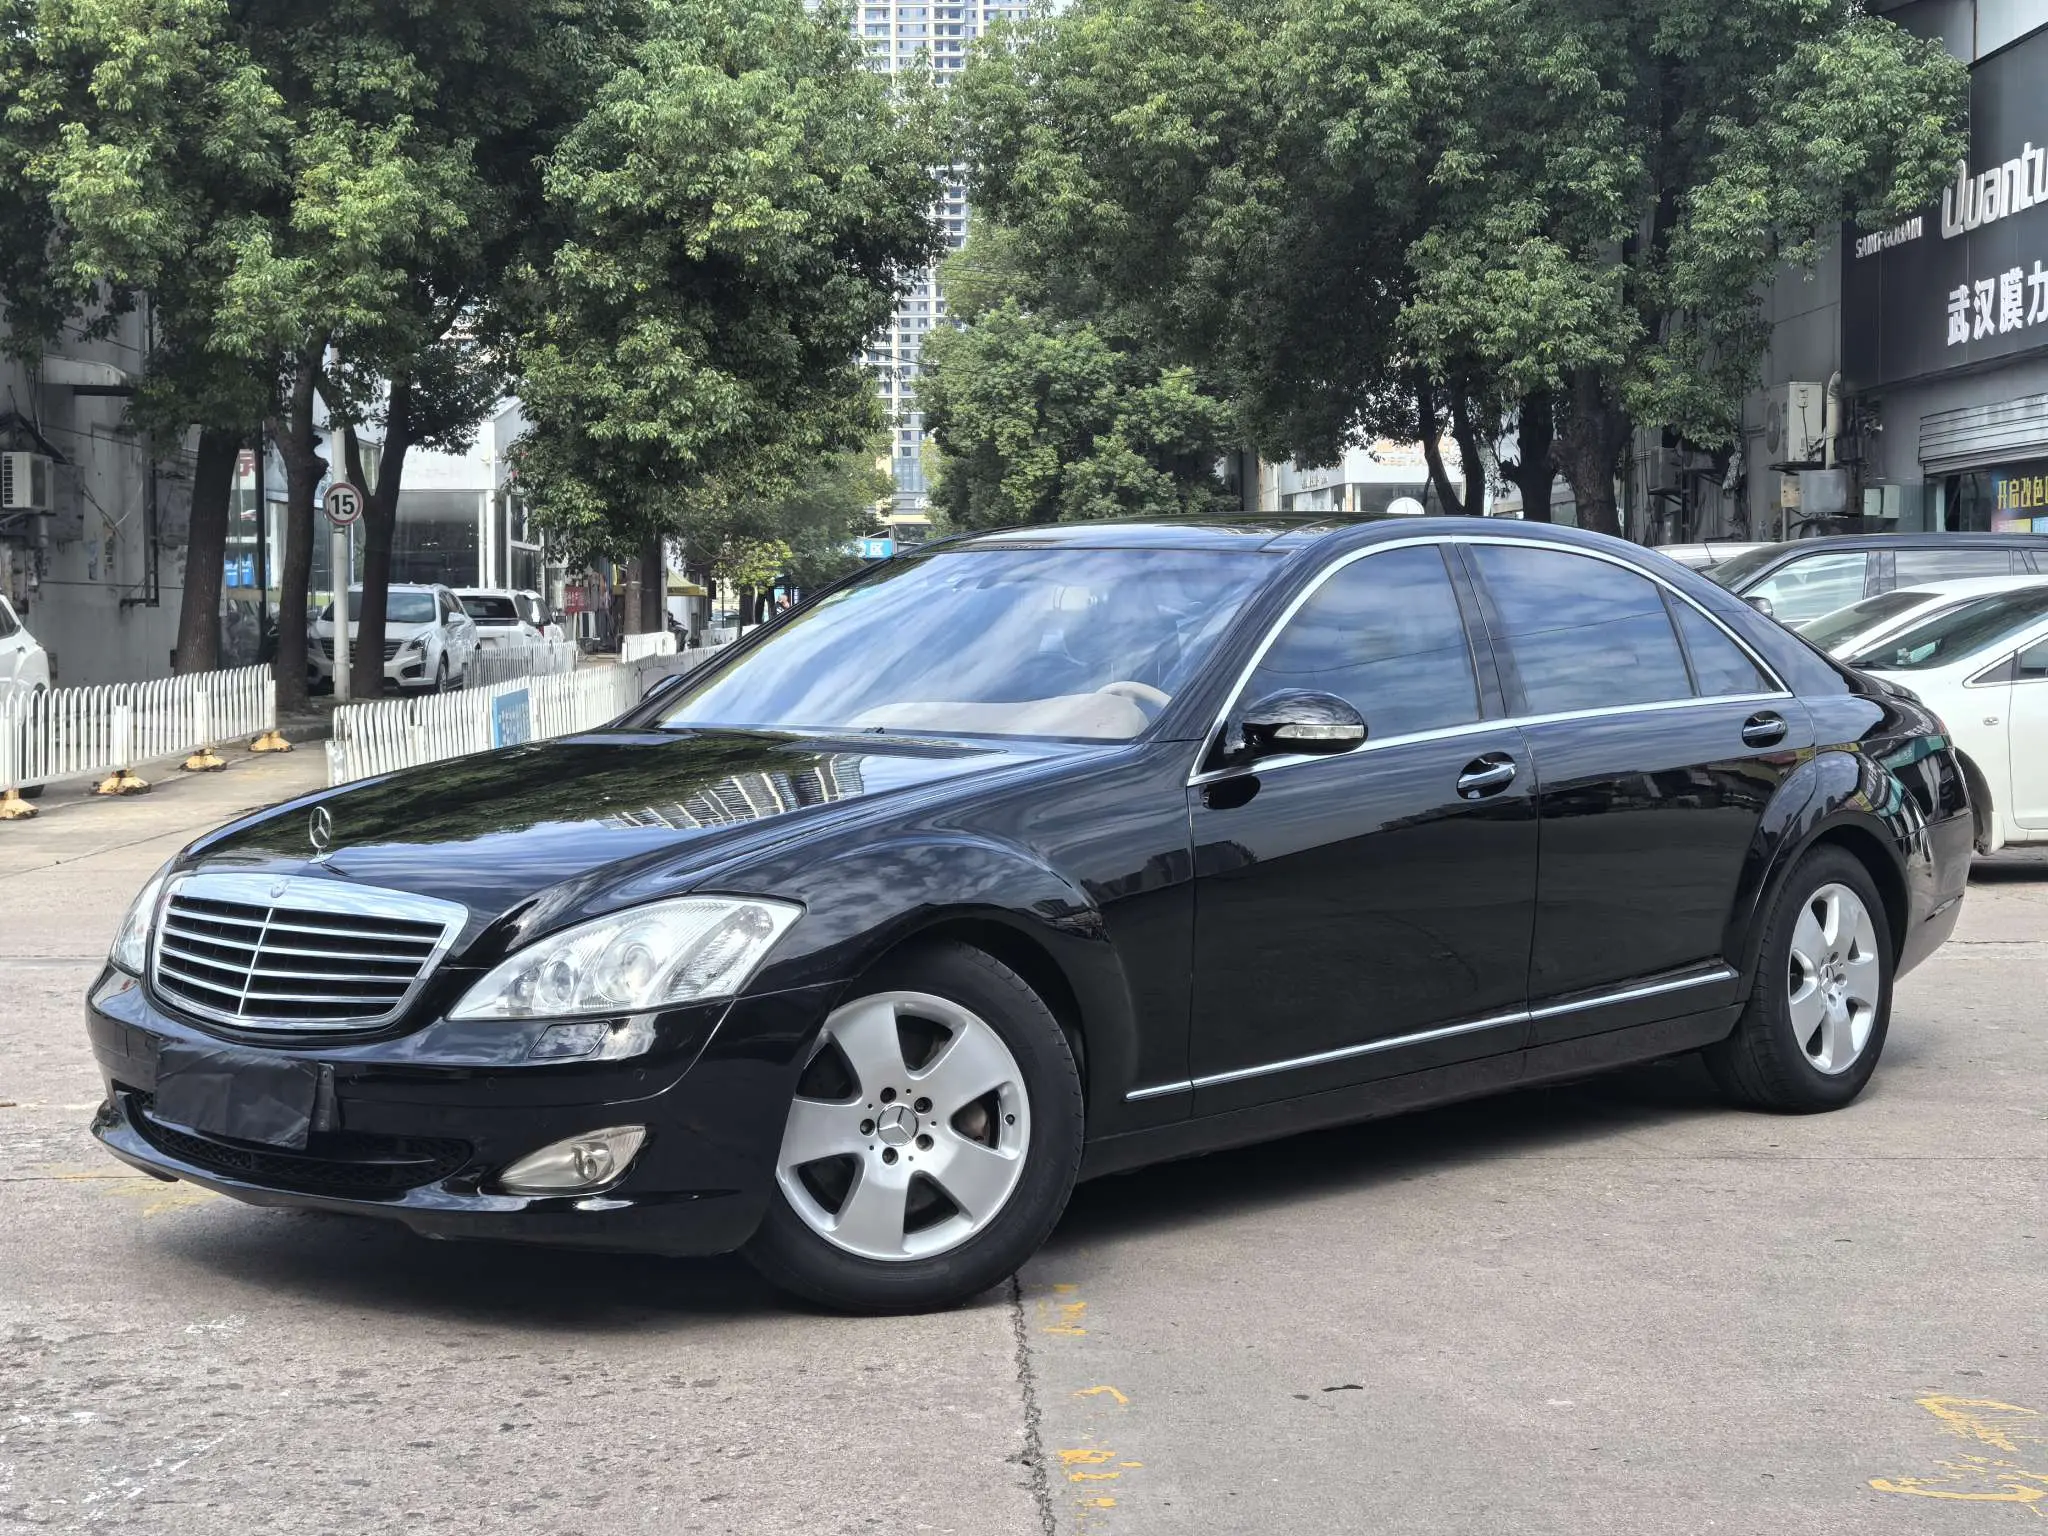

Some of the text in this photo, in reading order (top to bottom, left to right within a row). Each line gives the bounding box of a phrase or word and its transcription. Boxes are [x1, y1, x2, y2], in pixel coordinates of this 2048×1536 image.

[331, 494, 355, 515] 15
[1997, 475, 2048, 510] 开启改色
